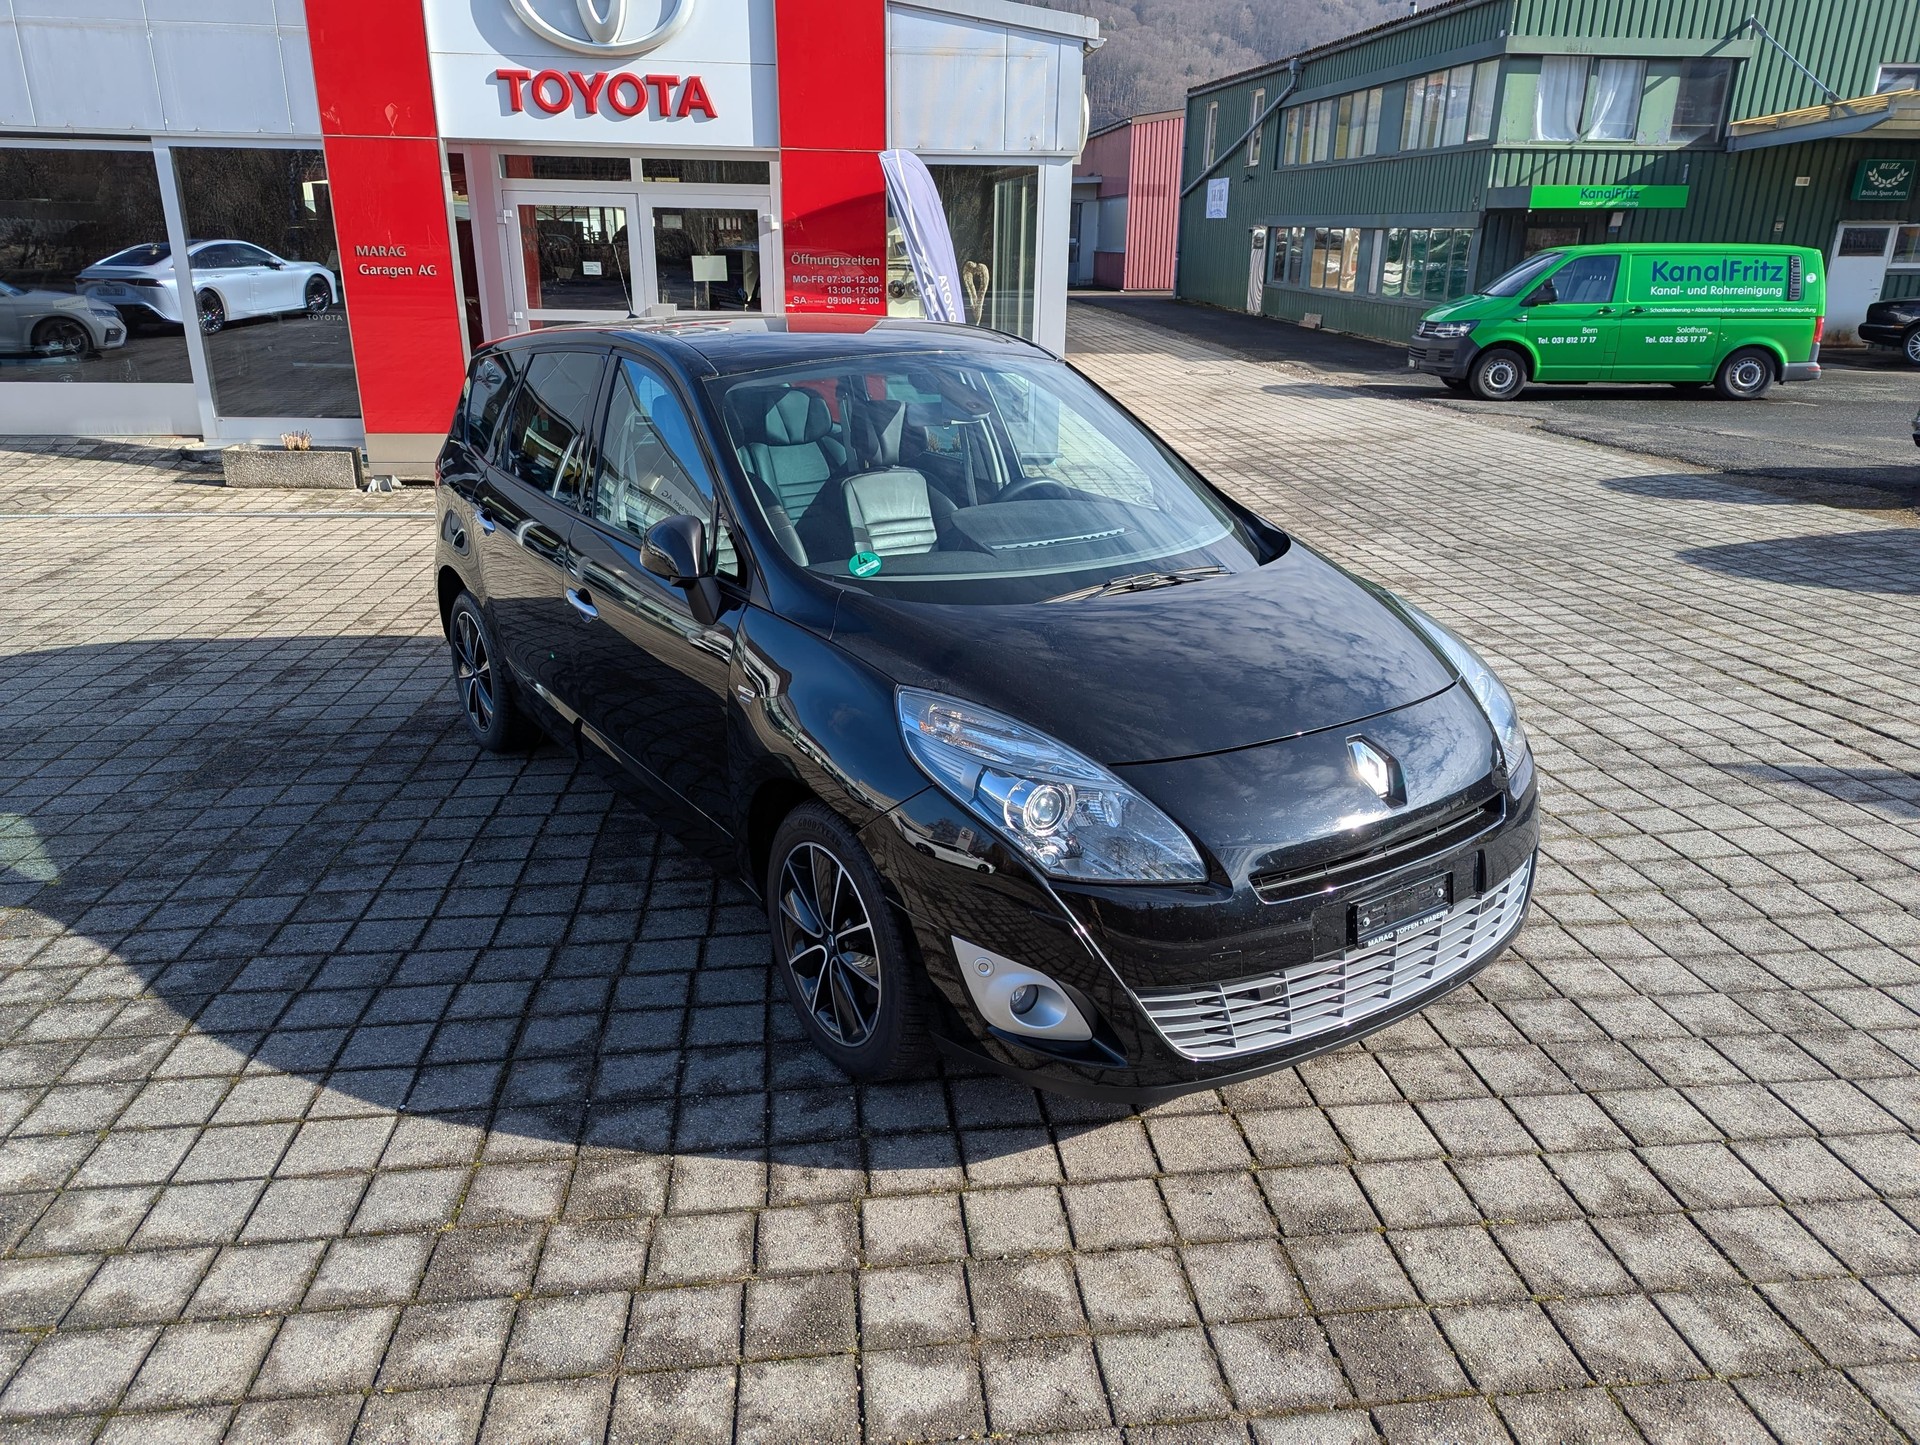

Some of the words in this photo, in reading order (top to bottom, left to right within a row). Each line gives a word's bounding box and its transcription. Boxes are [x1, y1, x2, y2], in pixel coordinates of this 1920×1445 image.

[496, 69, 718, 118] TOYOTA
[1580, 187, 1640, 199] KanalFritz
[355, 245, 407, 257] MARAG
[791, 252, 880, 268] Öffnungszeiten
[359, 263, 413, 278] Garagen
[418, 264, 437, 276] AG
[1651, 259, 1784, 282] KanalFritz
[793, 275, 824, 284] MO-FR
[826, 275, 879, 284] 07:30-12:00
[827, 286, 879, 294] 13:00-17:00
[1650, 285, 1684, 296] Kanal-
[1687, 285, 1707, 295] und
[1710, 285, 1783, 298] Rohrreinigung
[793, 296, 807, 304] SA
[827, 296, 880, 305] 09:00-12:00
[1677, 326, 1708, 334] Solothurn
[1551, 336, 1565, 344] 031
[1566, 336, 1578, 344] 812
[857, 554, 868, 565] 4
[1367, 931, 1394, 947] MARAG
[1396, 922, 1419, 936] TOFFEN
[1423, 910, 1449, 925] WABERN
